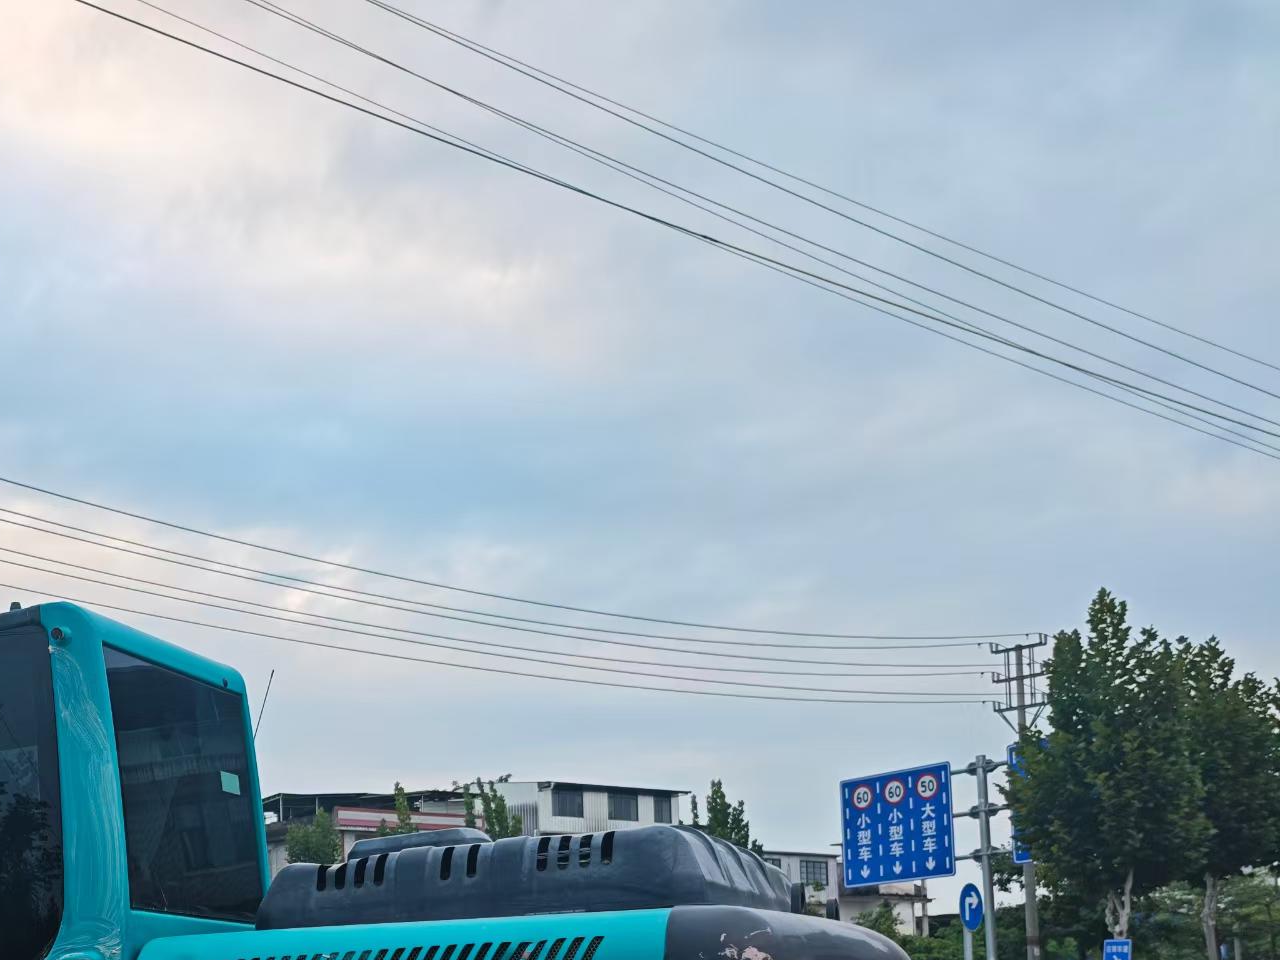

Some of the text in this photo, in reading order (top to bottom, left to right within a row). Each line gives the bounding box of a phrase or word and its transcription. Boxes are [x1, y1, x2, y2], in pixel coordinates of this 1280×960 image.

[855, 791, 869, 803] 60
[887, 785, 902, 798] 60
[920, 780, 934, 793] 50
[856, 813, 872, 862] 小型车
[888, 808, 904, 857] 小型车
[921, 803, 937, 853] 大型车
